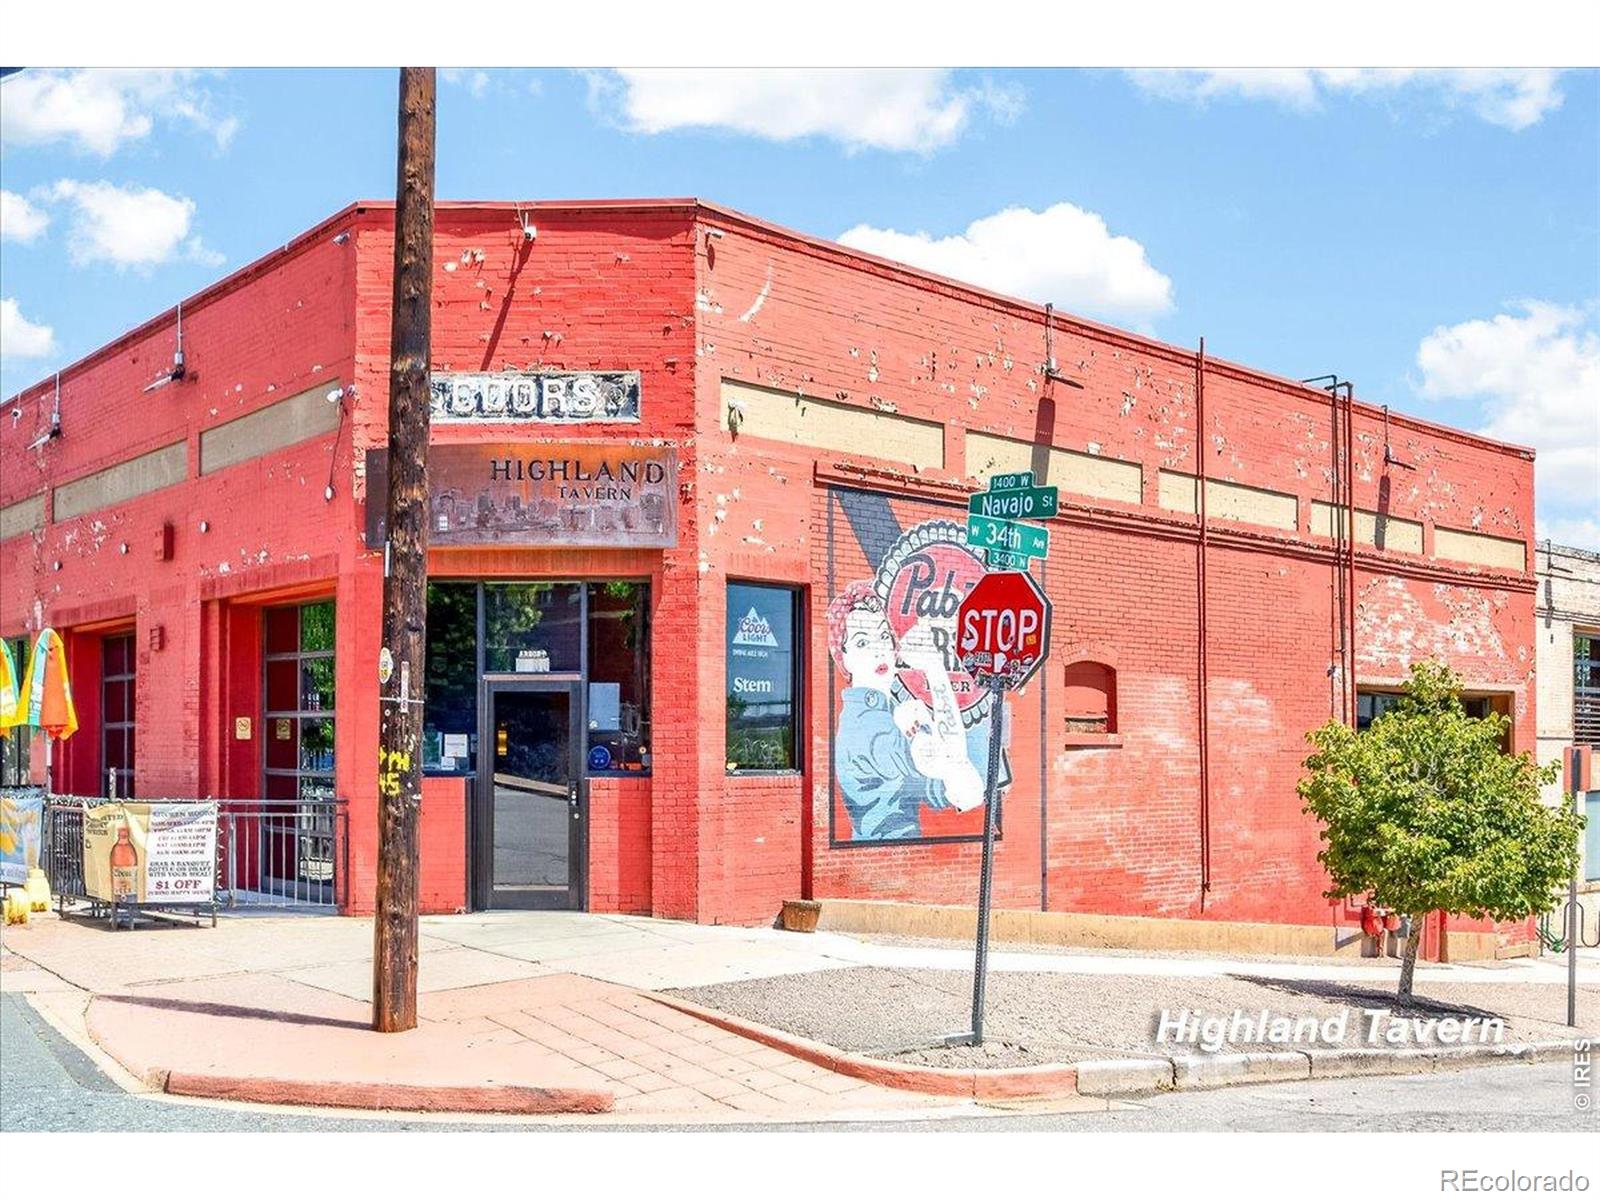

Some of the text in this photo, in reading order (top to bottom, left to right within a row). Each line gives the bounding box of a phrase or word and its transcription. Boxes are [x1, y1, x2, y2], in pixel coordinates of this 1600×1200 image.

[490, 460, 665, 484] HIGHLAND
[993, 474, 1030, 489] 1400 W
[558, 487, 632, 500] TAVERN
[982, 492, 1053, 518] Navajo St
[971, 525, 980, 537] W
[985, 522, 1022, 549] 34th
[992, 552, 1027, 568] 3400 N
[740, 617, 773, 635] Coors
[961, 609, 1038, 652] STOP
[743, 634, 767, 642] LIGHT
[733, 676, 771, 693] Stem
[155, 879, 202, 890] $1 OFF
